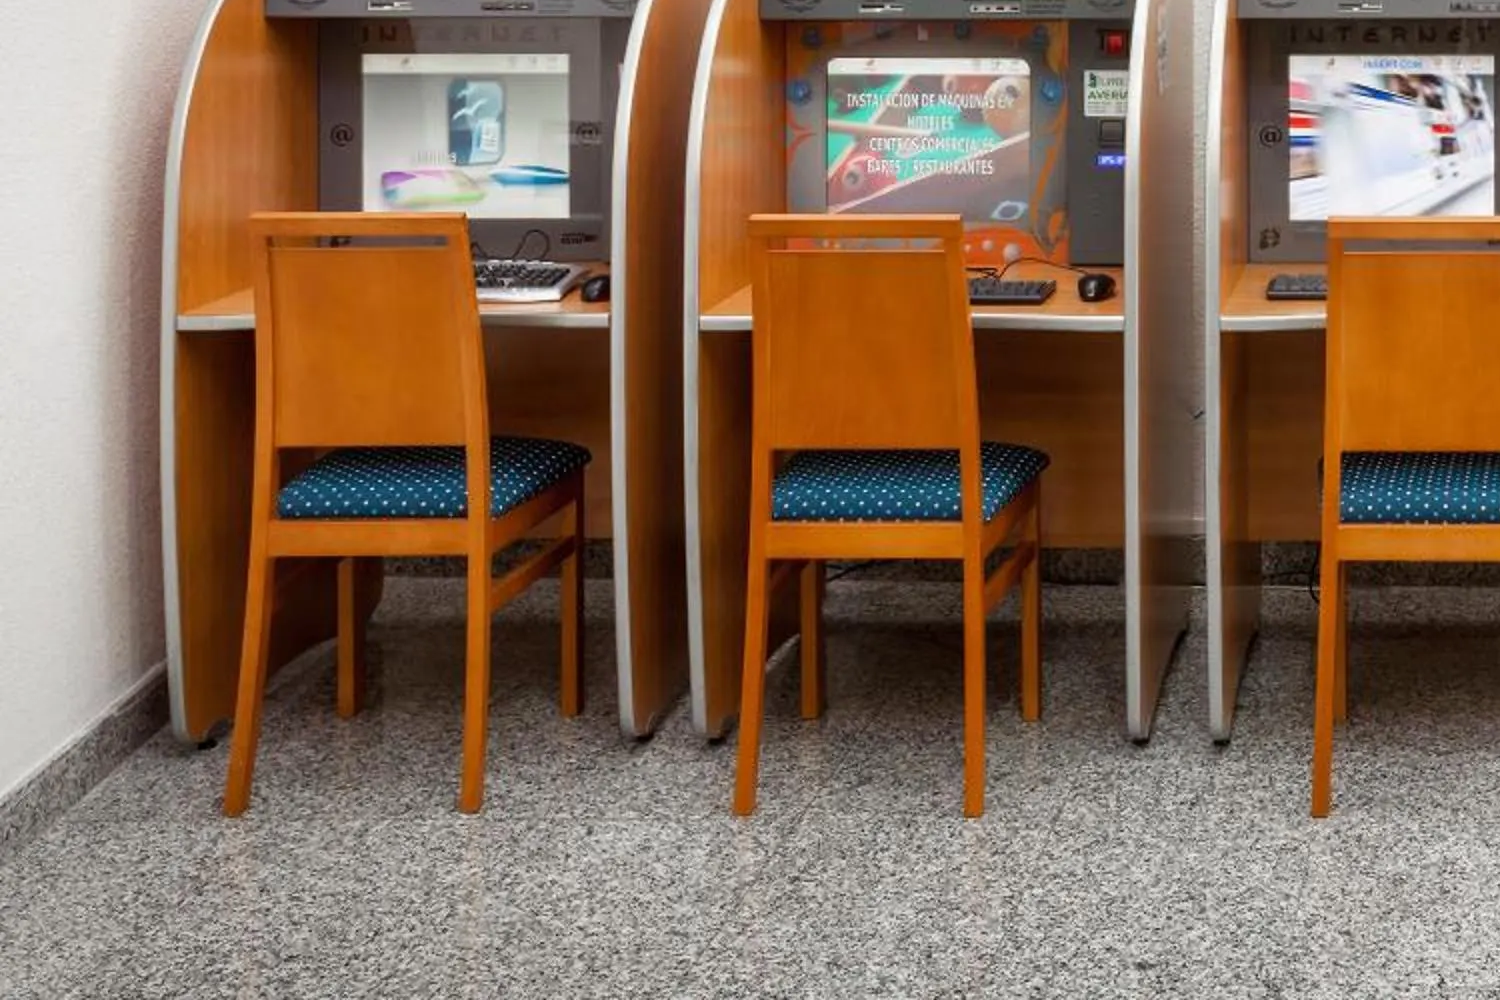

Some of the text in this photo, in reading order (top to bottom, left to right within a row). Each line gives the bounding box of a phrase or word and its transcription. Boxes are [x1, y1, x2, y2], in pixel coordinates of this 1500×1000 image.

[1289, 24, 1493, 44] INTERNET
[921, 93, 934, 108] DE
[907, 115, 954, 130] HOTELES
[868, 137, 994, 152] CENTROS COMERCIALES
[912, 159, 993, 175] RESTAURANTES
